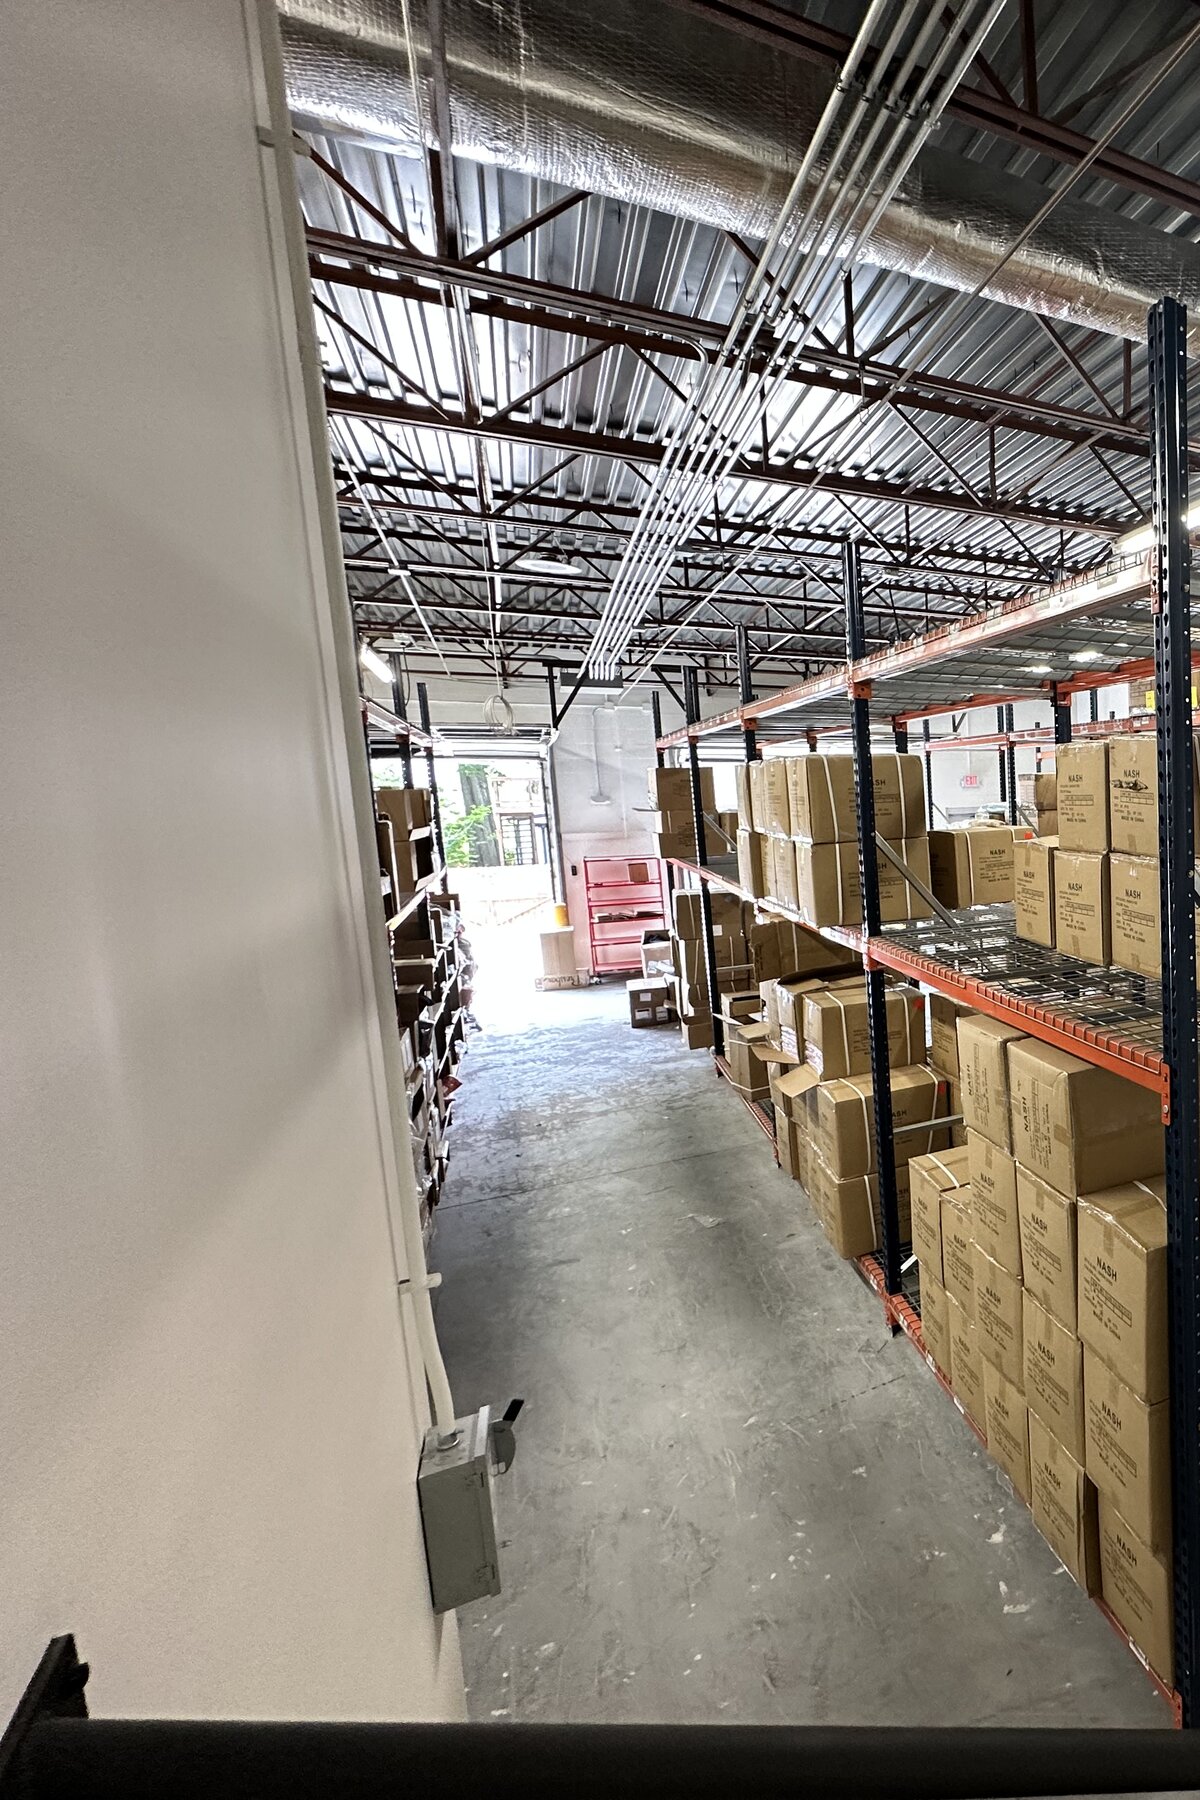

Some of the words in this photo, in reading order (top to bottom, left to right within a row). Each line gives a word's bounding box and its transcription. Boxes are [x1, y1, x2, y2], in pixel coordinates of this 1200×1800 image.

[1068, 775, 1083, 783] NASH
[1124, 769, 1140, 779] NASH
[1023, 870, 1035, 879] NASH
[1068, 882, 1083, 892] NASH
[1125, 889, 1141, 900] NASH
[892, 1110, 907, 1118] ASH
[1097, 1256, 1117, 1281] NASH
[1038, 1340, 1055, 1366] NASH
[1102, 1400, 1122, 1430] NASH
[1117, 1533, 1137, 1567] NASH
